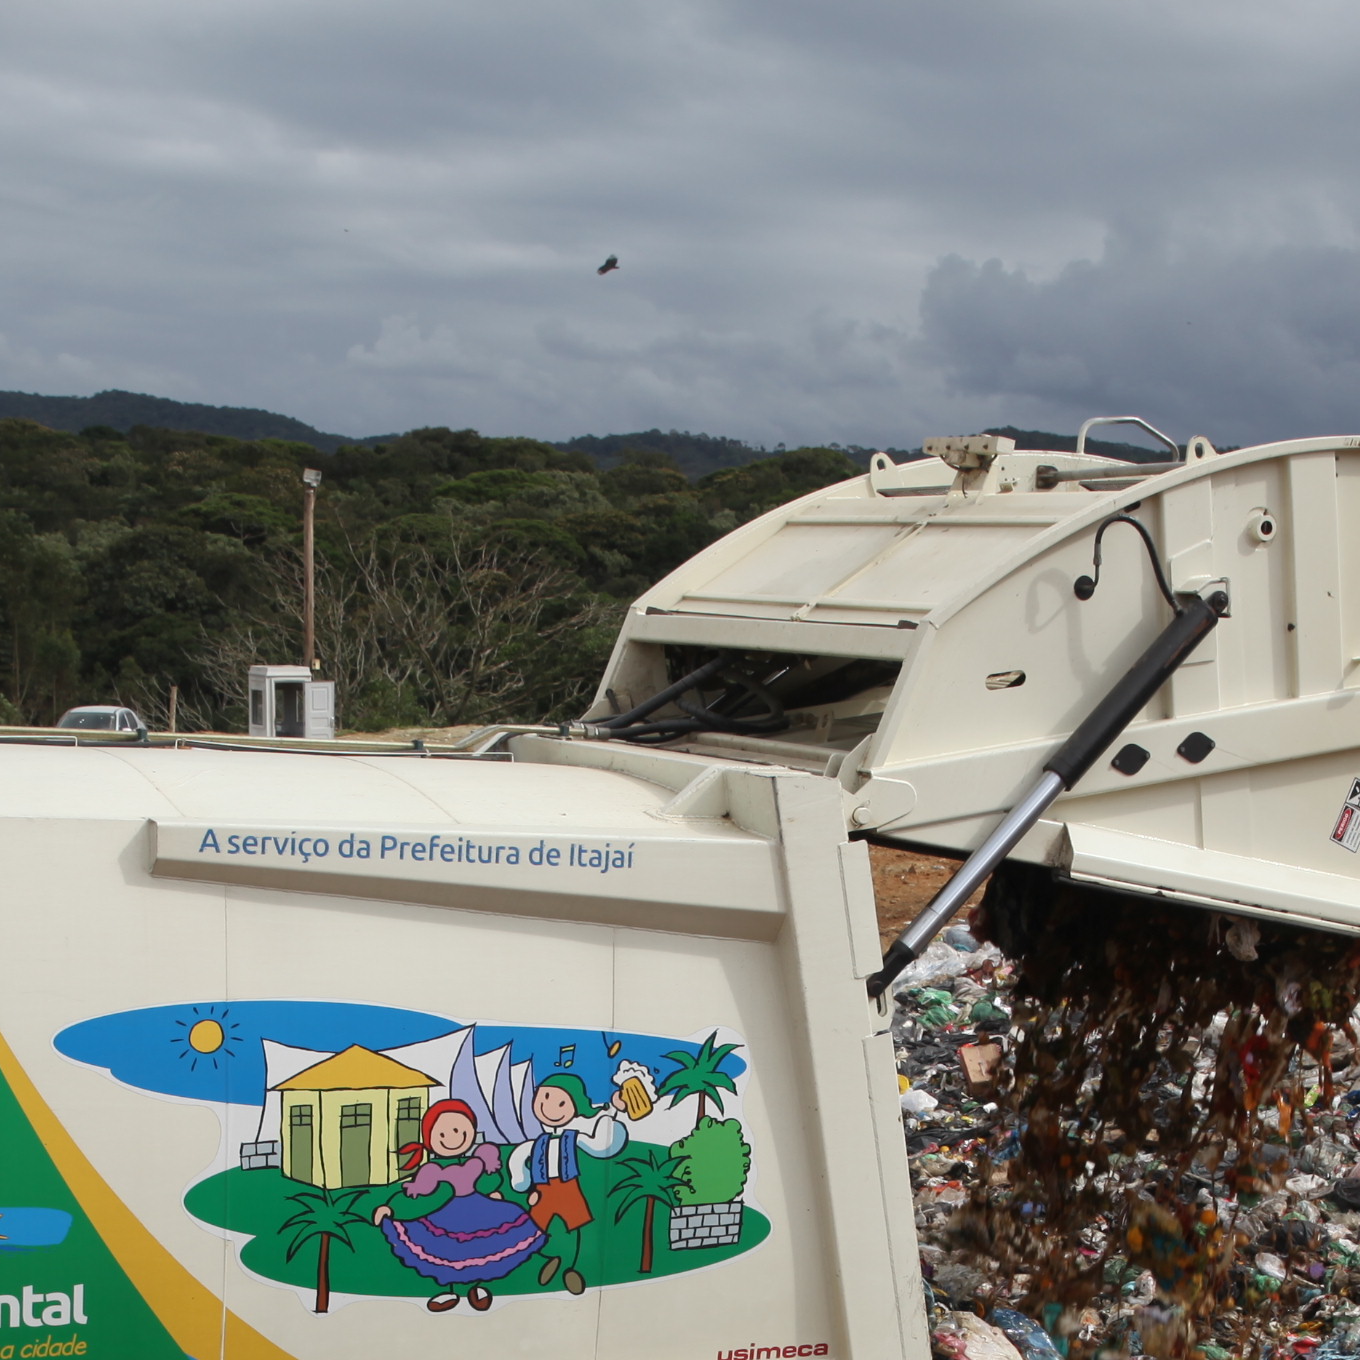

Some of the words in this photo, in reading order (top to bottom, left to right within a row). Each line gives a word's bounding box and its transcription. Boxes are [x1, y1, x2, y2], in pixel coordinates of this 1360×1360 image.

[198, 828, 221, 854] A
[227, 831, 330, 863] serviço
[338, 833, 372, 859] da
[380, 835, 521, 865] Prefeitura
[529, 840, 562, 867] de
[570, 842, 637, 873] Itajaí
[19, 1334, 88, 1359] cidade
